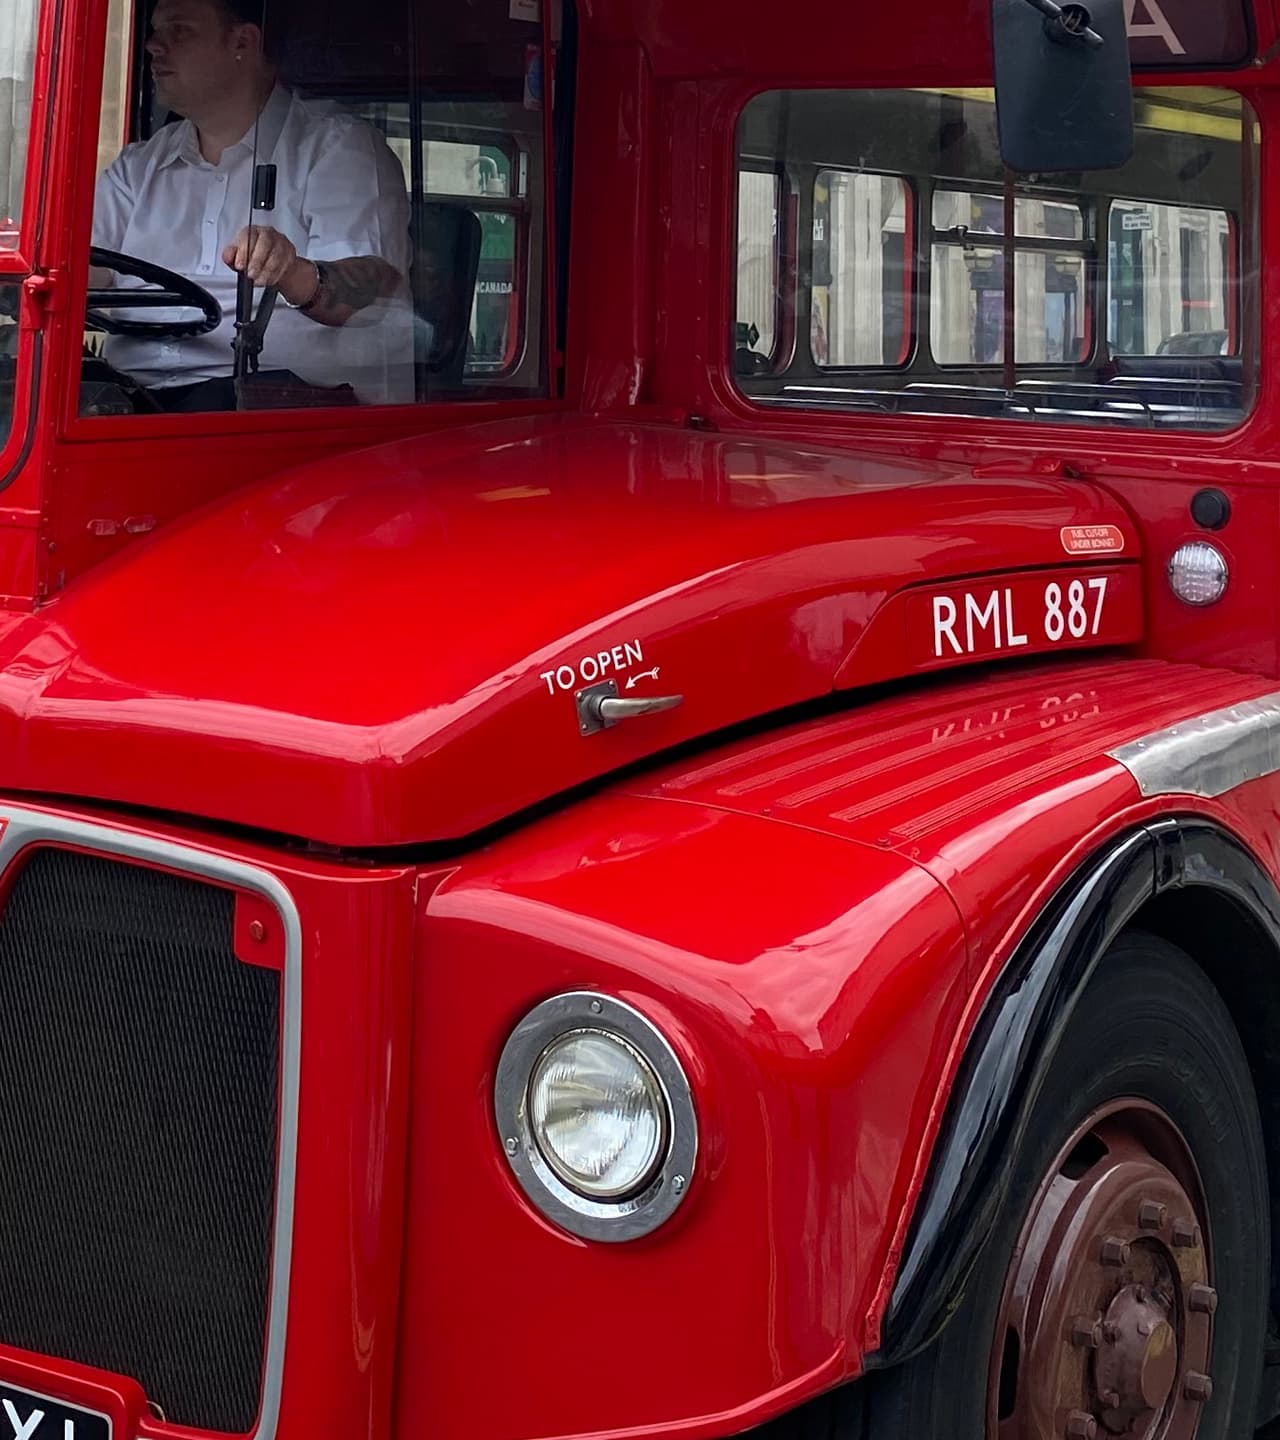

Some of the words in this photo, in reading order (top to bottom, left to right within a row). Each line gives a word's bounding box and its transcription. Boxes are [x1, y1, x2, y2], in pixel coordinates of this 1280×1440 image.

[932, 588, 1028, 657] RML
[1044, 577, 1108, 642] 887
[540, 665, 575, 696] TO
[580, 639, 643, 681] OPEN
